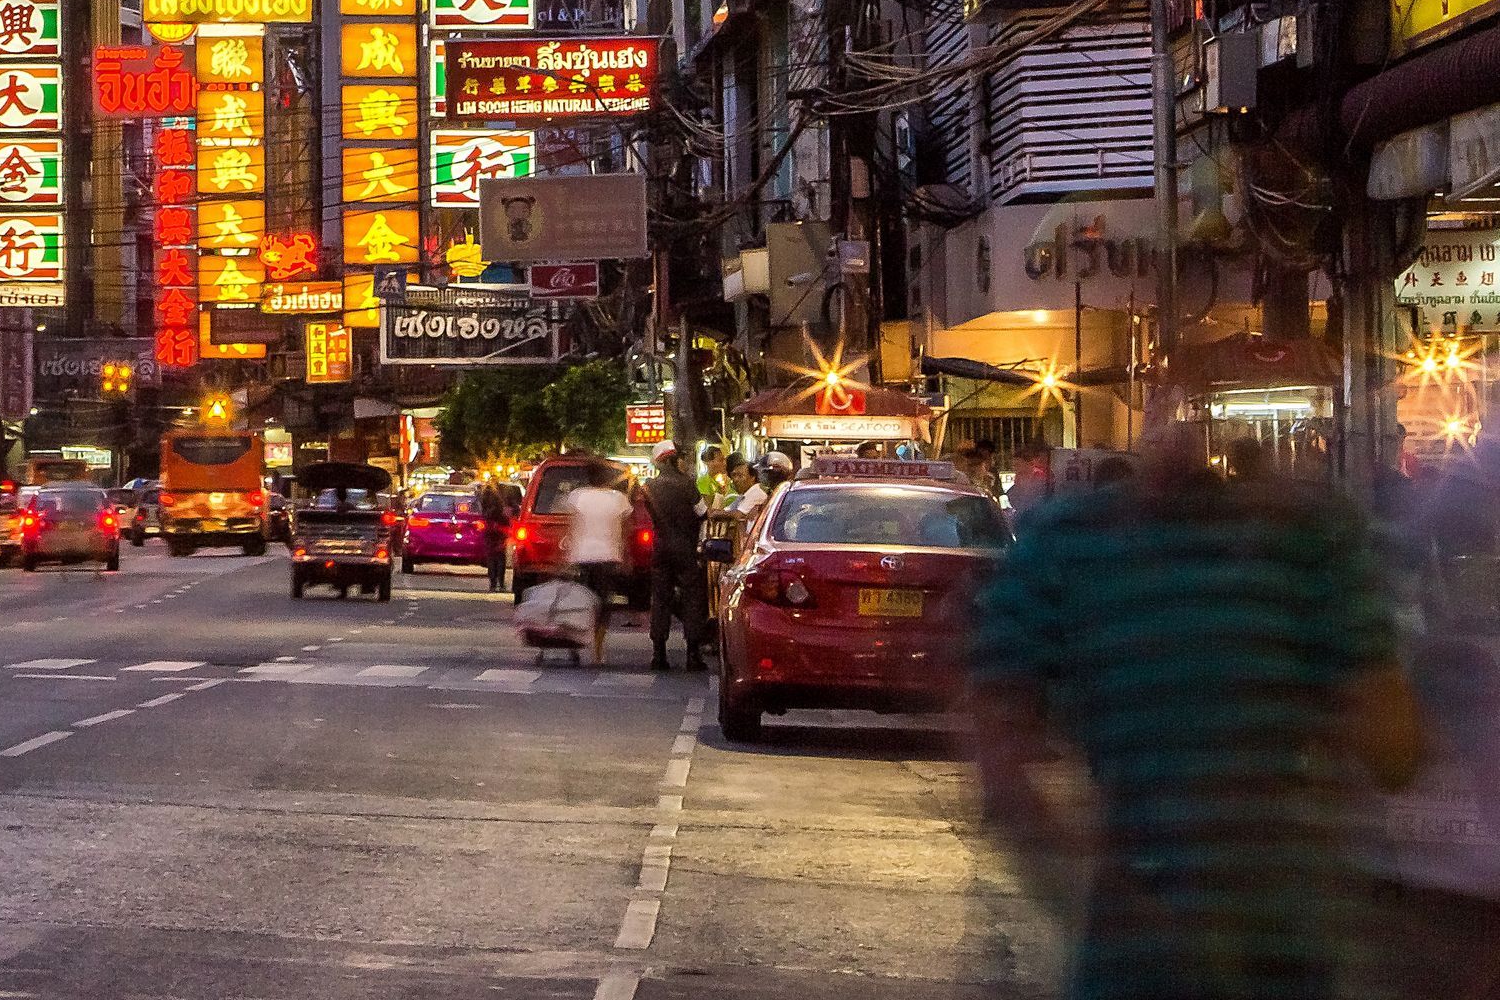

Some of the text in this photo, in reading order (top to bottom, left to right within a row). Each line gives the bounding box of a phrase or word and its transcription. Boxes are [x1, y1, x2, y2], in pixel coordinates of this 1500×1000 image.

[95, 46, 197, 112] จินฮั้วเ
[543, 99, 594, 114] NATURAL
[209, 39, 259, 352] 聯成興大金
[841, 421, 901, 432] SEAFOOD
